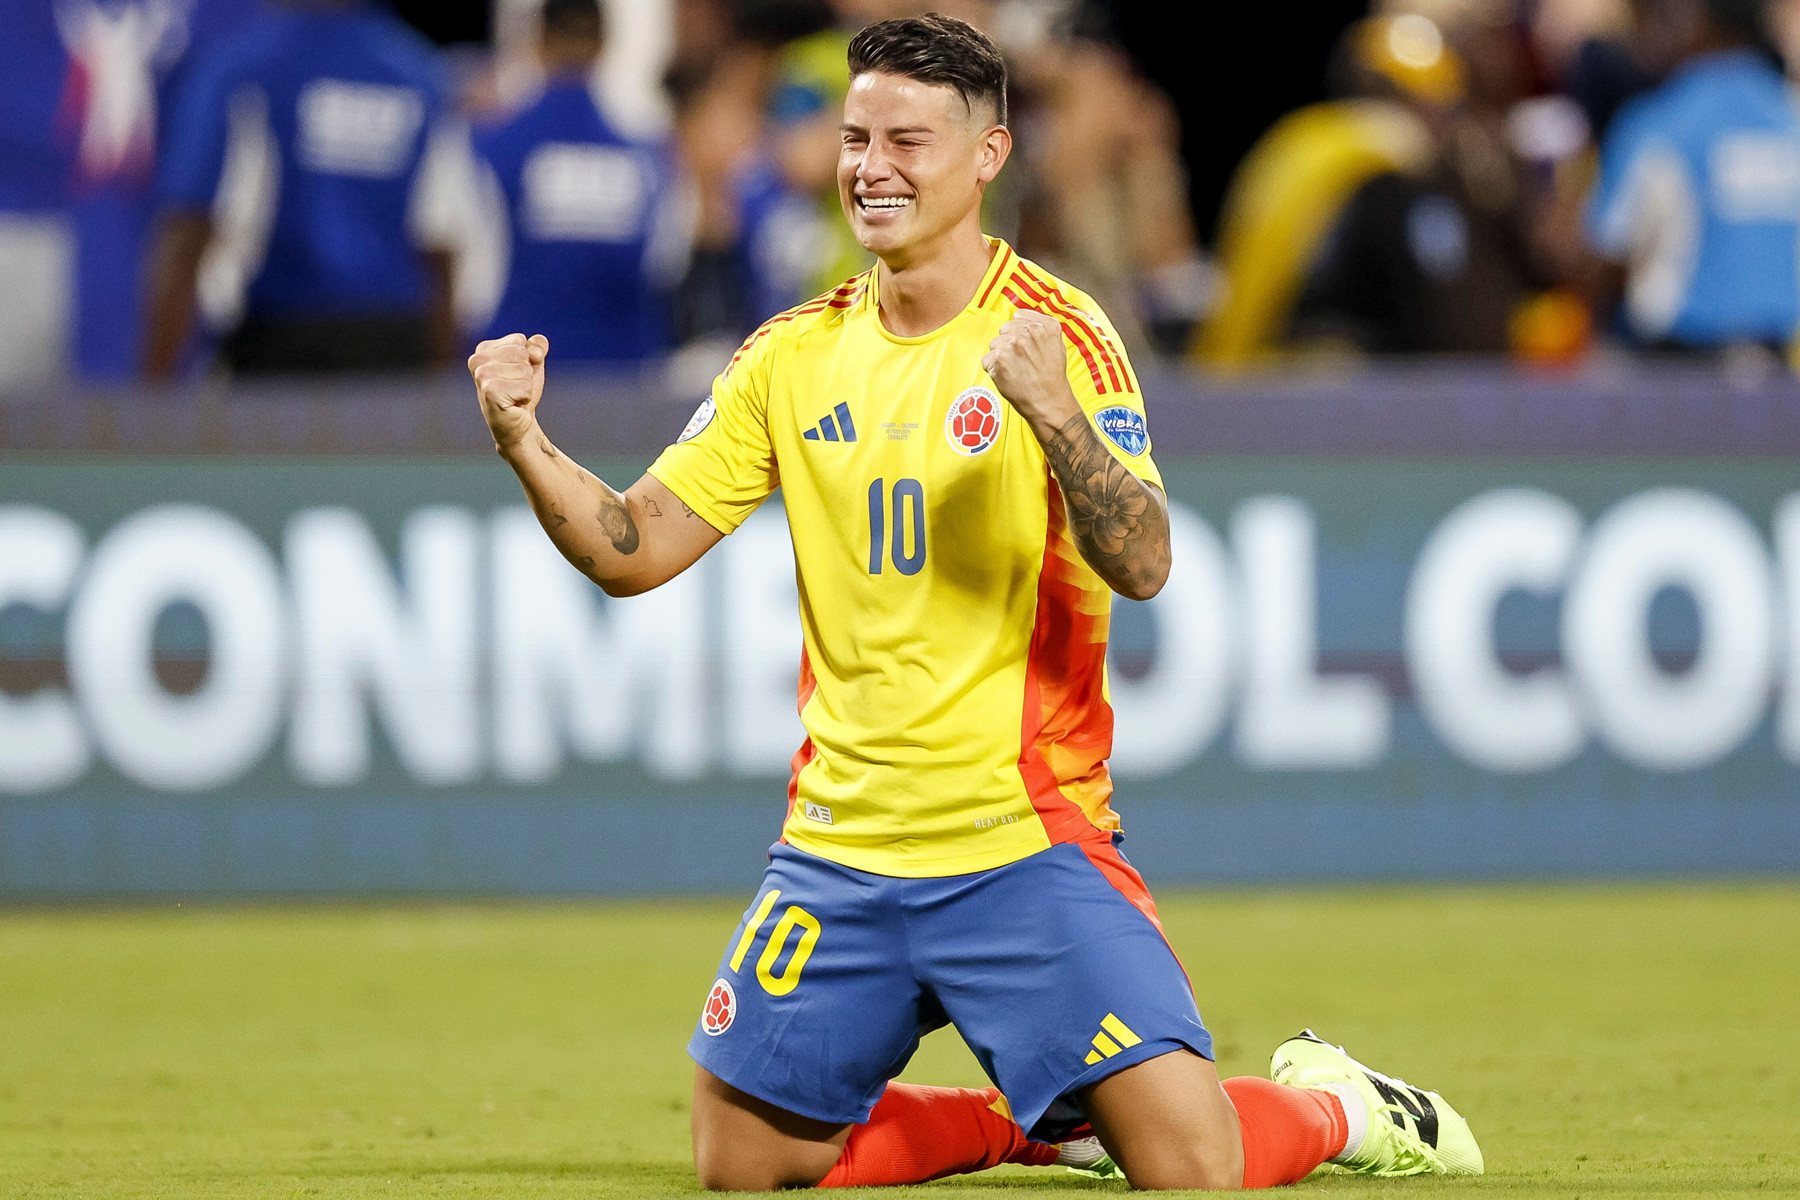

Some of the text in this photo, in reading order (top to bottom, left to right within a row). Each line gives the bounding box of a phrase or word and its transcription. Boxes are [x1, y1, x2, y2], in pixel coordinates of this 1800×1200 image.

[1105, 419, 1142, 431] VIBRA
[868, 477, 927, 576] 10
[0, 489, 1800, 788] CONMEOL CO
[974, 813, 1020, 829] HEAT RDY
[729, 889, 822, 997] 10
